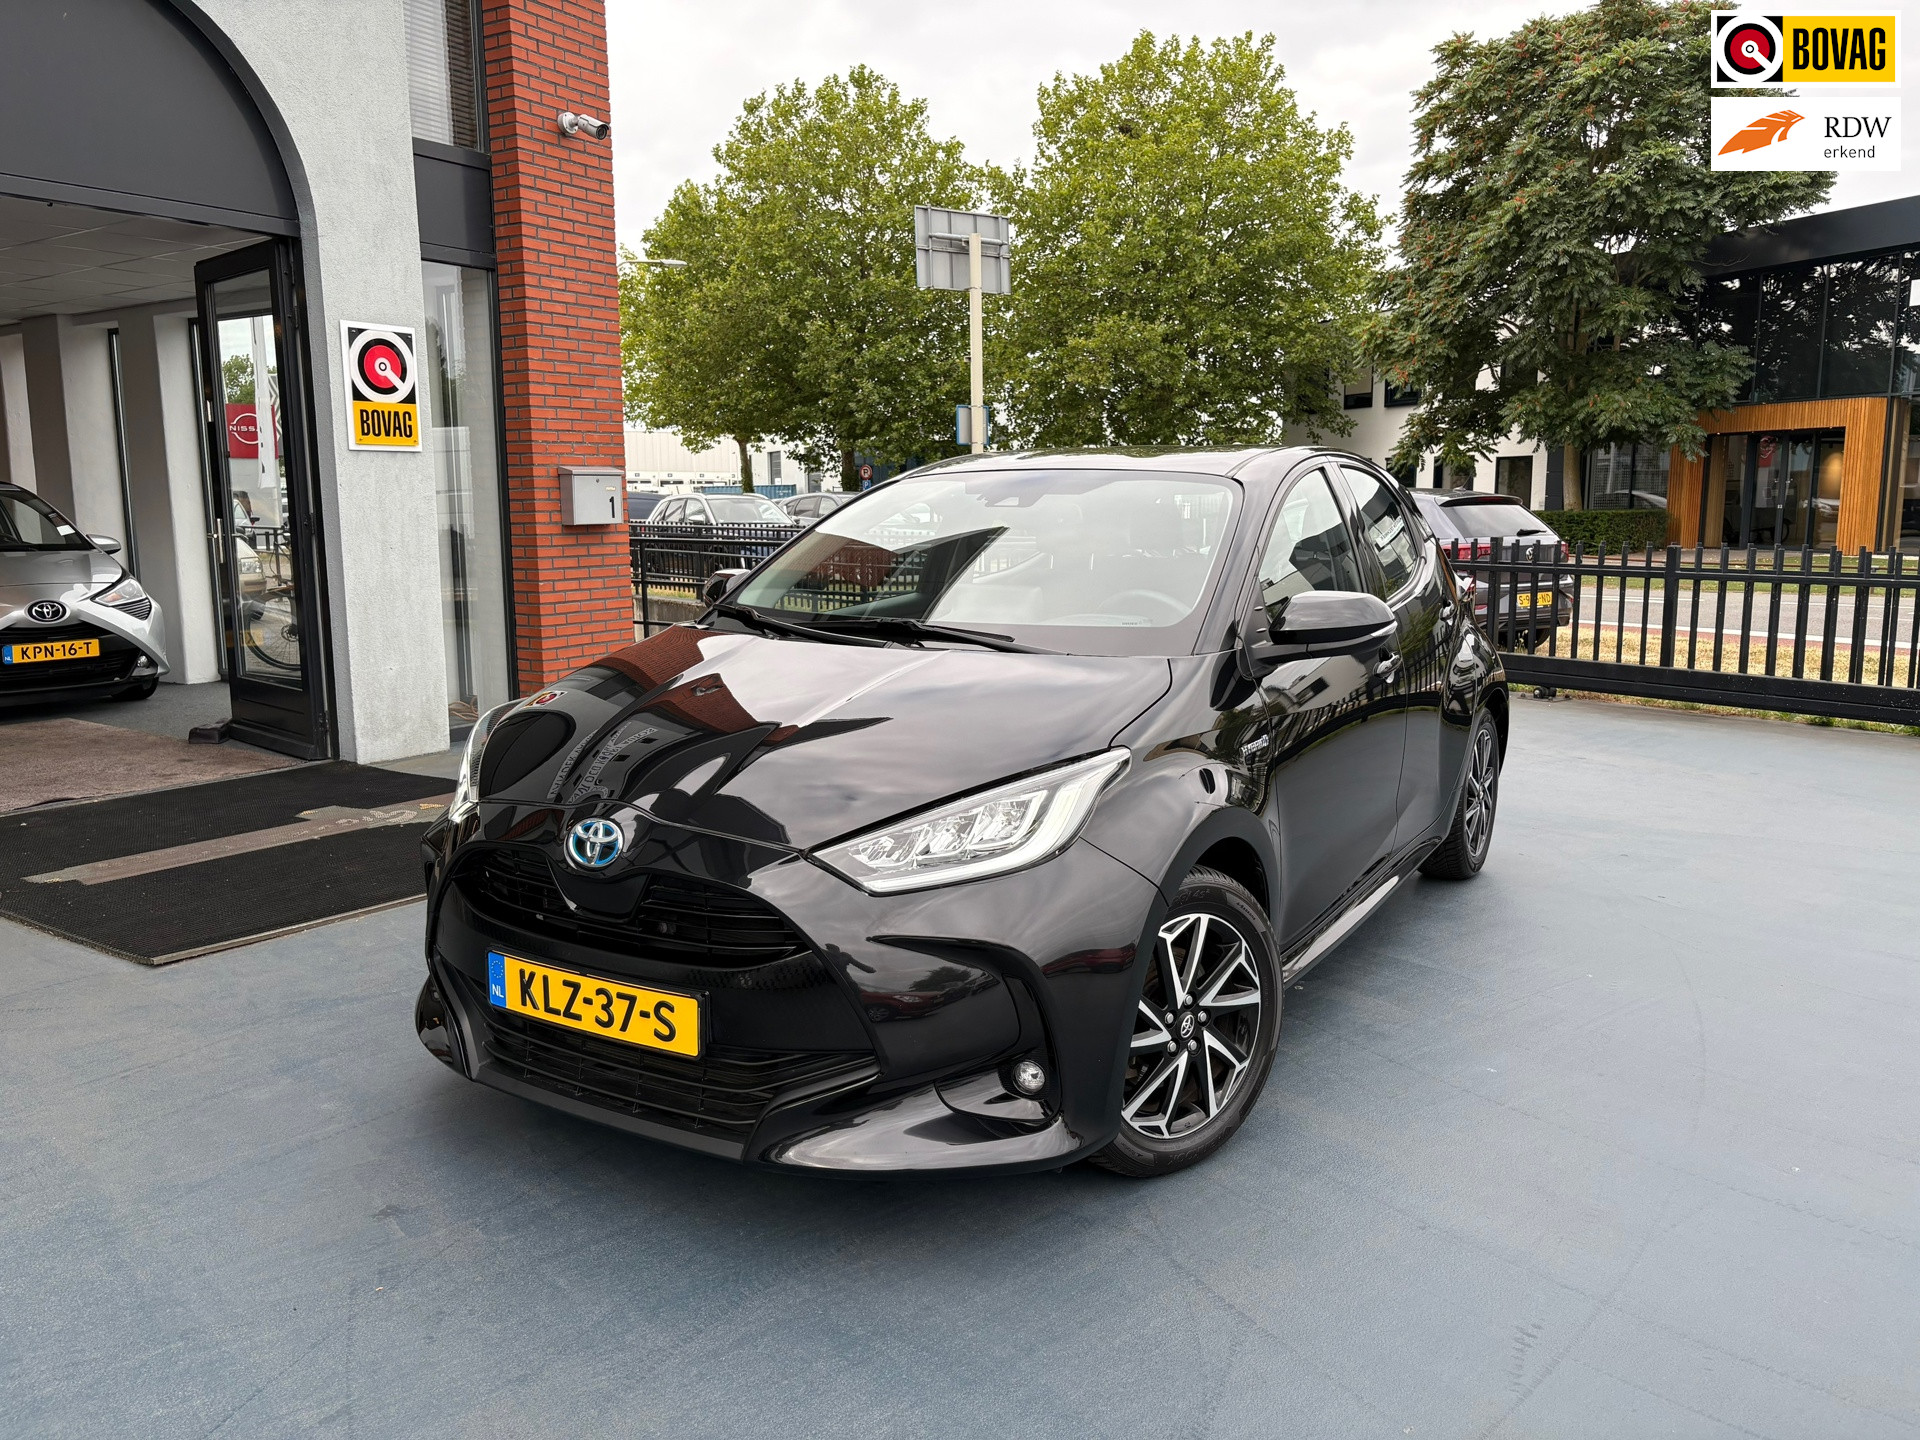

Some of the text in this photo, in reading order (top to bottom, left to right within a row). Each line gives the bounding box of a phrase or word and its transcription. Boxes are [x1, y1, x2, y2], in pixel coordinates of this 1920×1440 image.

[360, 409, 413, 438] BOVAG
[609, 496, 615, 518] 1
[1518, 593, 1551, 605] S-9-ND
[21, 642, 92, 660] KPN-16-T
[492, 968, 677, 1043] NL KLZ-37-S
